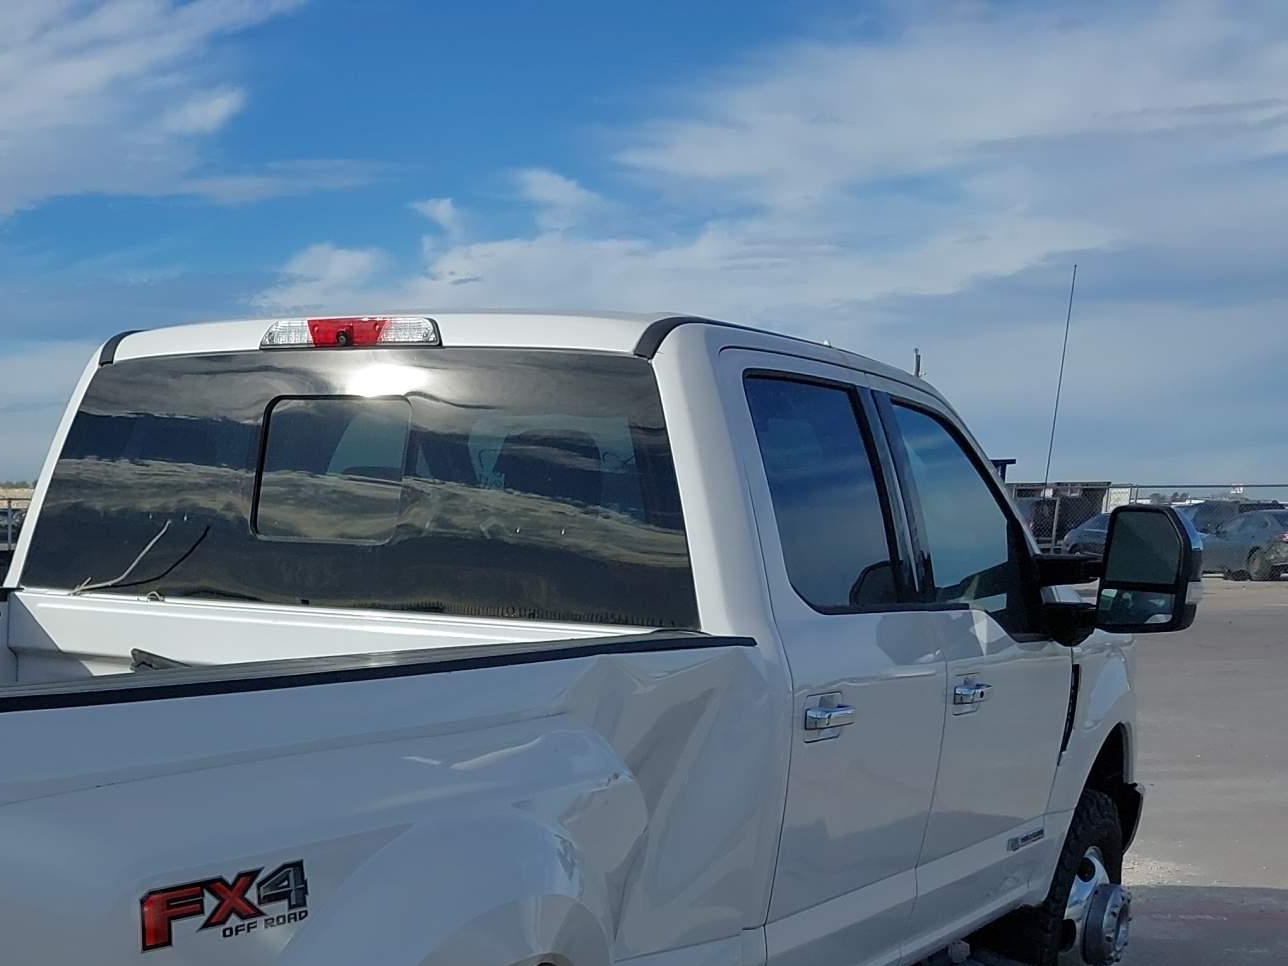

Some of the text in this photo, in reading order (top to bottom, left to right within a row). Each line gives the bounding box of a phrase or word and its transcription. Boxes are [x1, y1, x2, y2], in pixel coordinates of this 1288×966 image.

[140, 858, 309, 953] FX4
[222, 909, 309, 939] OFF ROAD
